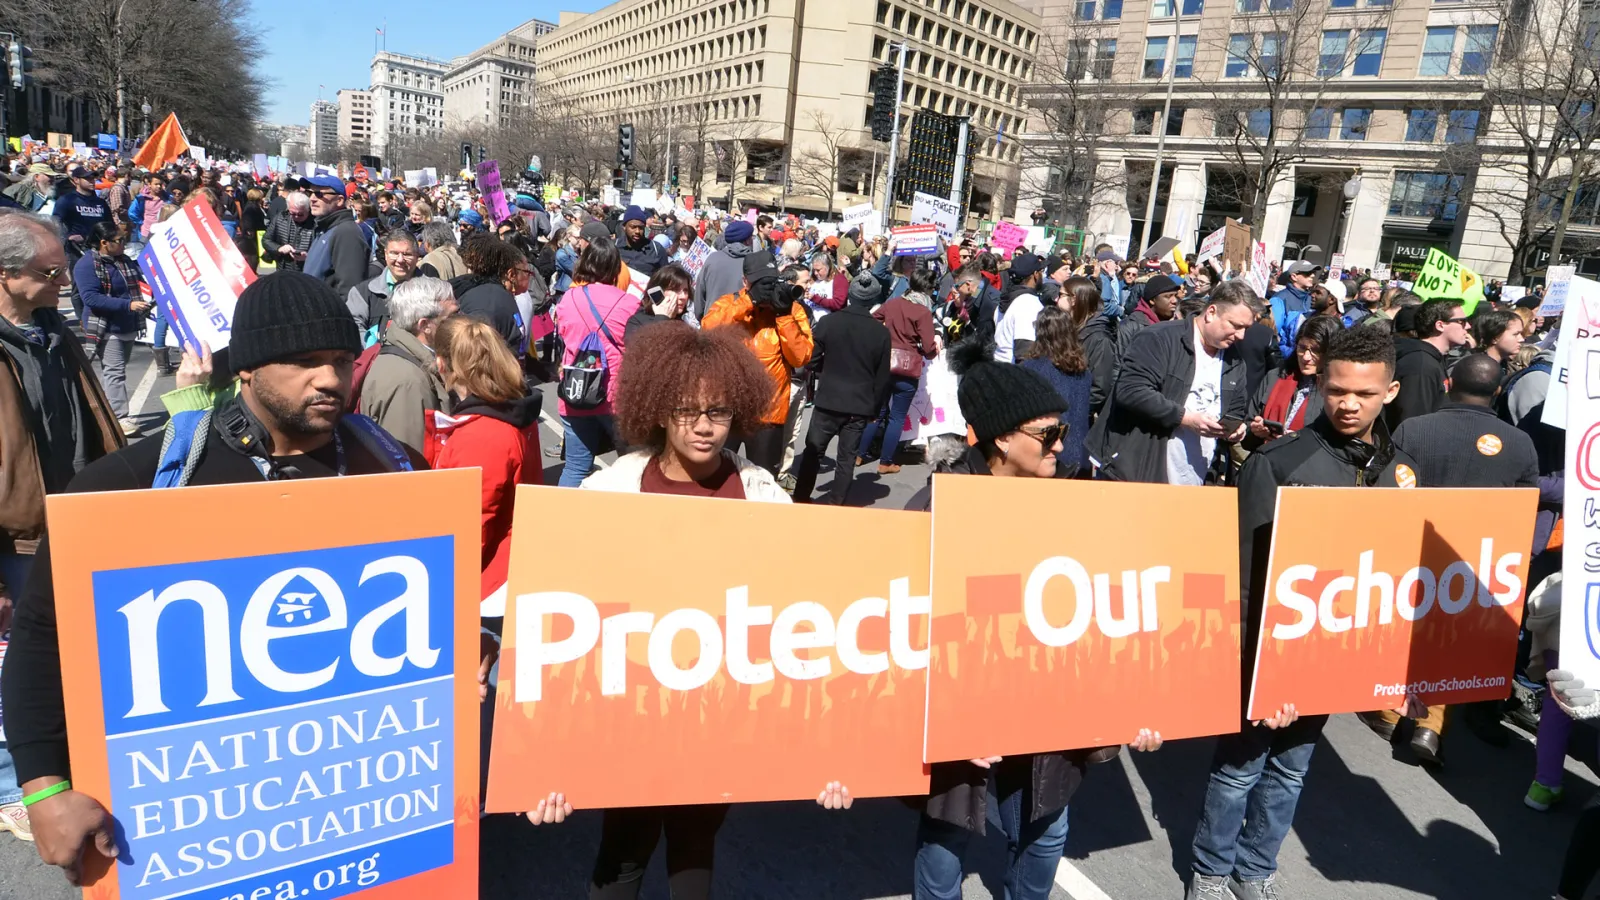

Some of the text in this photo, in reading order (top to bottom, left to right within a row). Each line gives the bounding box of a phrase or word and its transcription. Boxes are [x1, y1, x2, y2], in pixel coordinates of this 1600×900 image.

[76, 204, 104, 213] UCONN
[844, 208, 872, 221] ENOUGH
[932, 199, 958, 216] FORGET
[1396, 246, 1428, 257] PAUL
[164, 227, 180, 249] NO
[172, 245, 200, 285] NRA
[190, 279, 231, 333] MONEY
[1417, 272, 1453, 293] NOT
[1429, 250, 1460, 278] LOVE
[1023, 556, 1171, 647] Our
[1271, 537, 1522, 640] Schools
[116, 554, 442, 719] nea
[515, 576, 930, 703] Protect
[1373, 676, 1506, 697] ProtectOurSchools.com
[125, 696, 441, 789] NATIONAL
[130, 740, 443, 841] EDUCATION
[135, 783, 442, 888] ASSOCIATION
